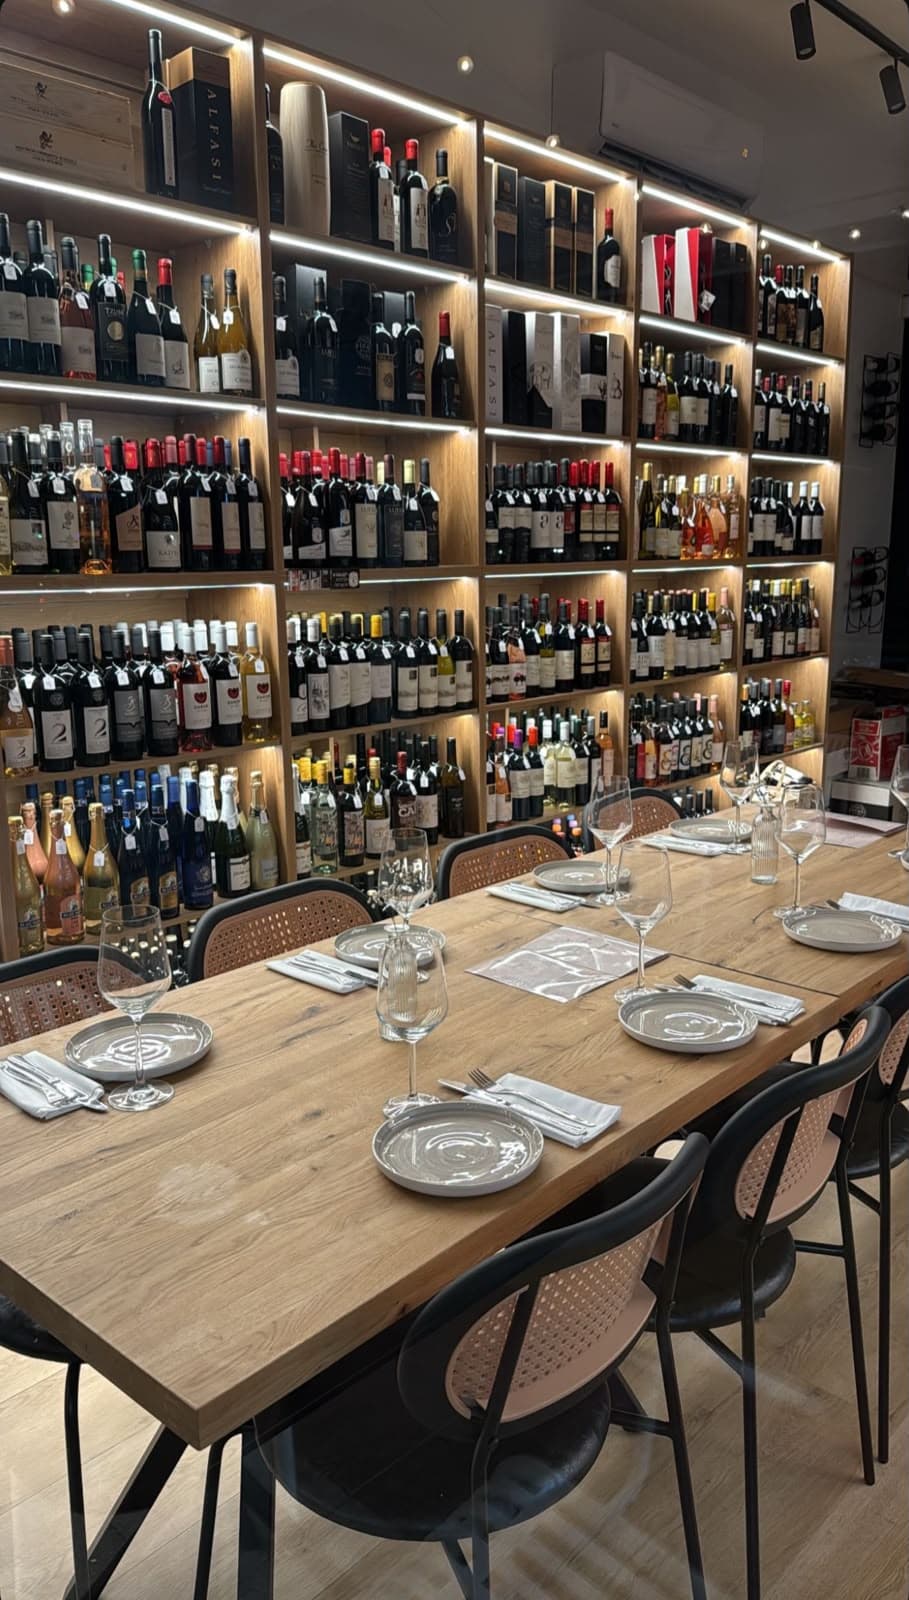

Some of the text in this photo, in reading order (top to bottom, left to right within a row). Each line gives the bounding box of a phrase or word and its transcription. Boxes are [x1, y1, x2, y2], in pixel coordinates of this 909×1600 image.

[207, 89, 222, 181] ALFASI
[488, 330, 497, 417] ALFASI
[51, 723, 67, 744] 2
[94, 718, 107, 737] 2
